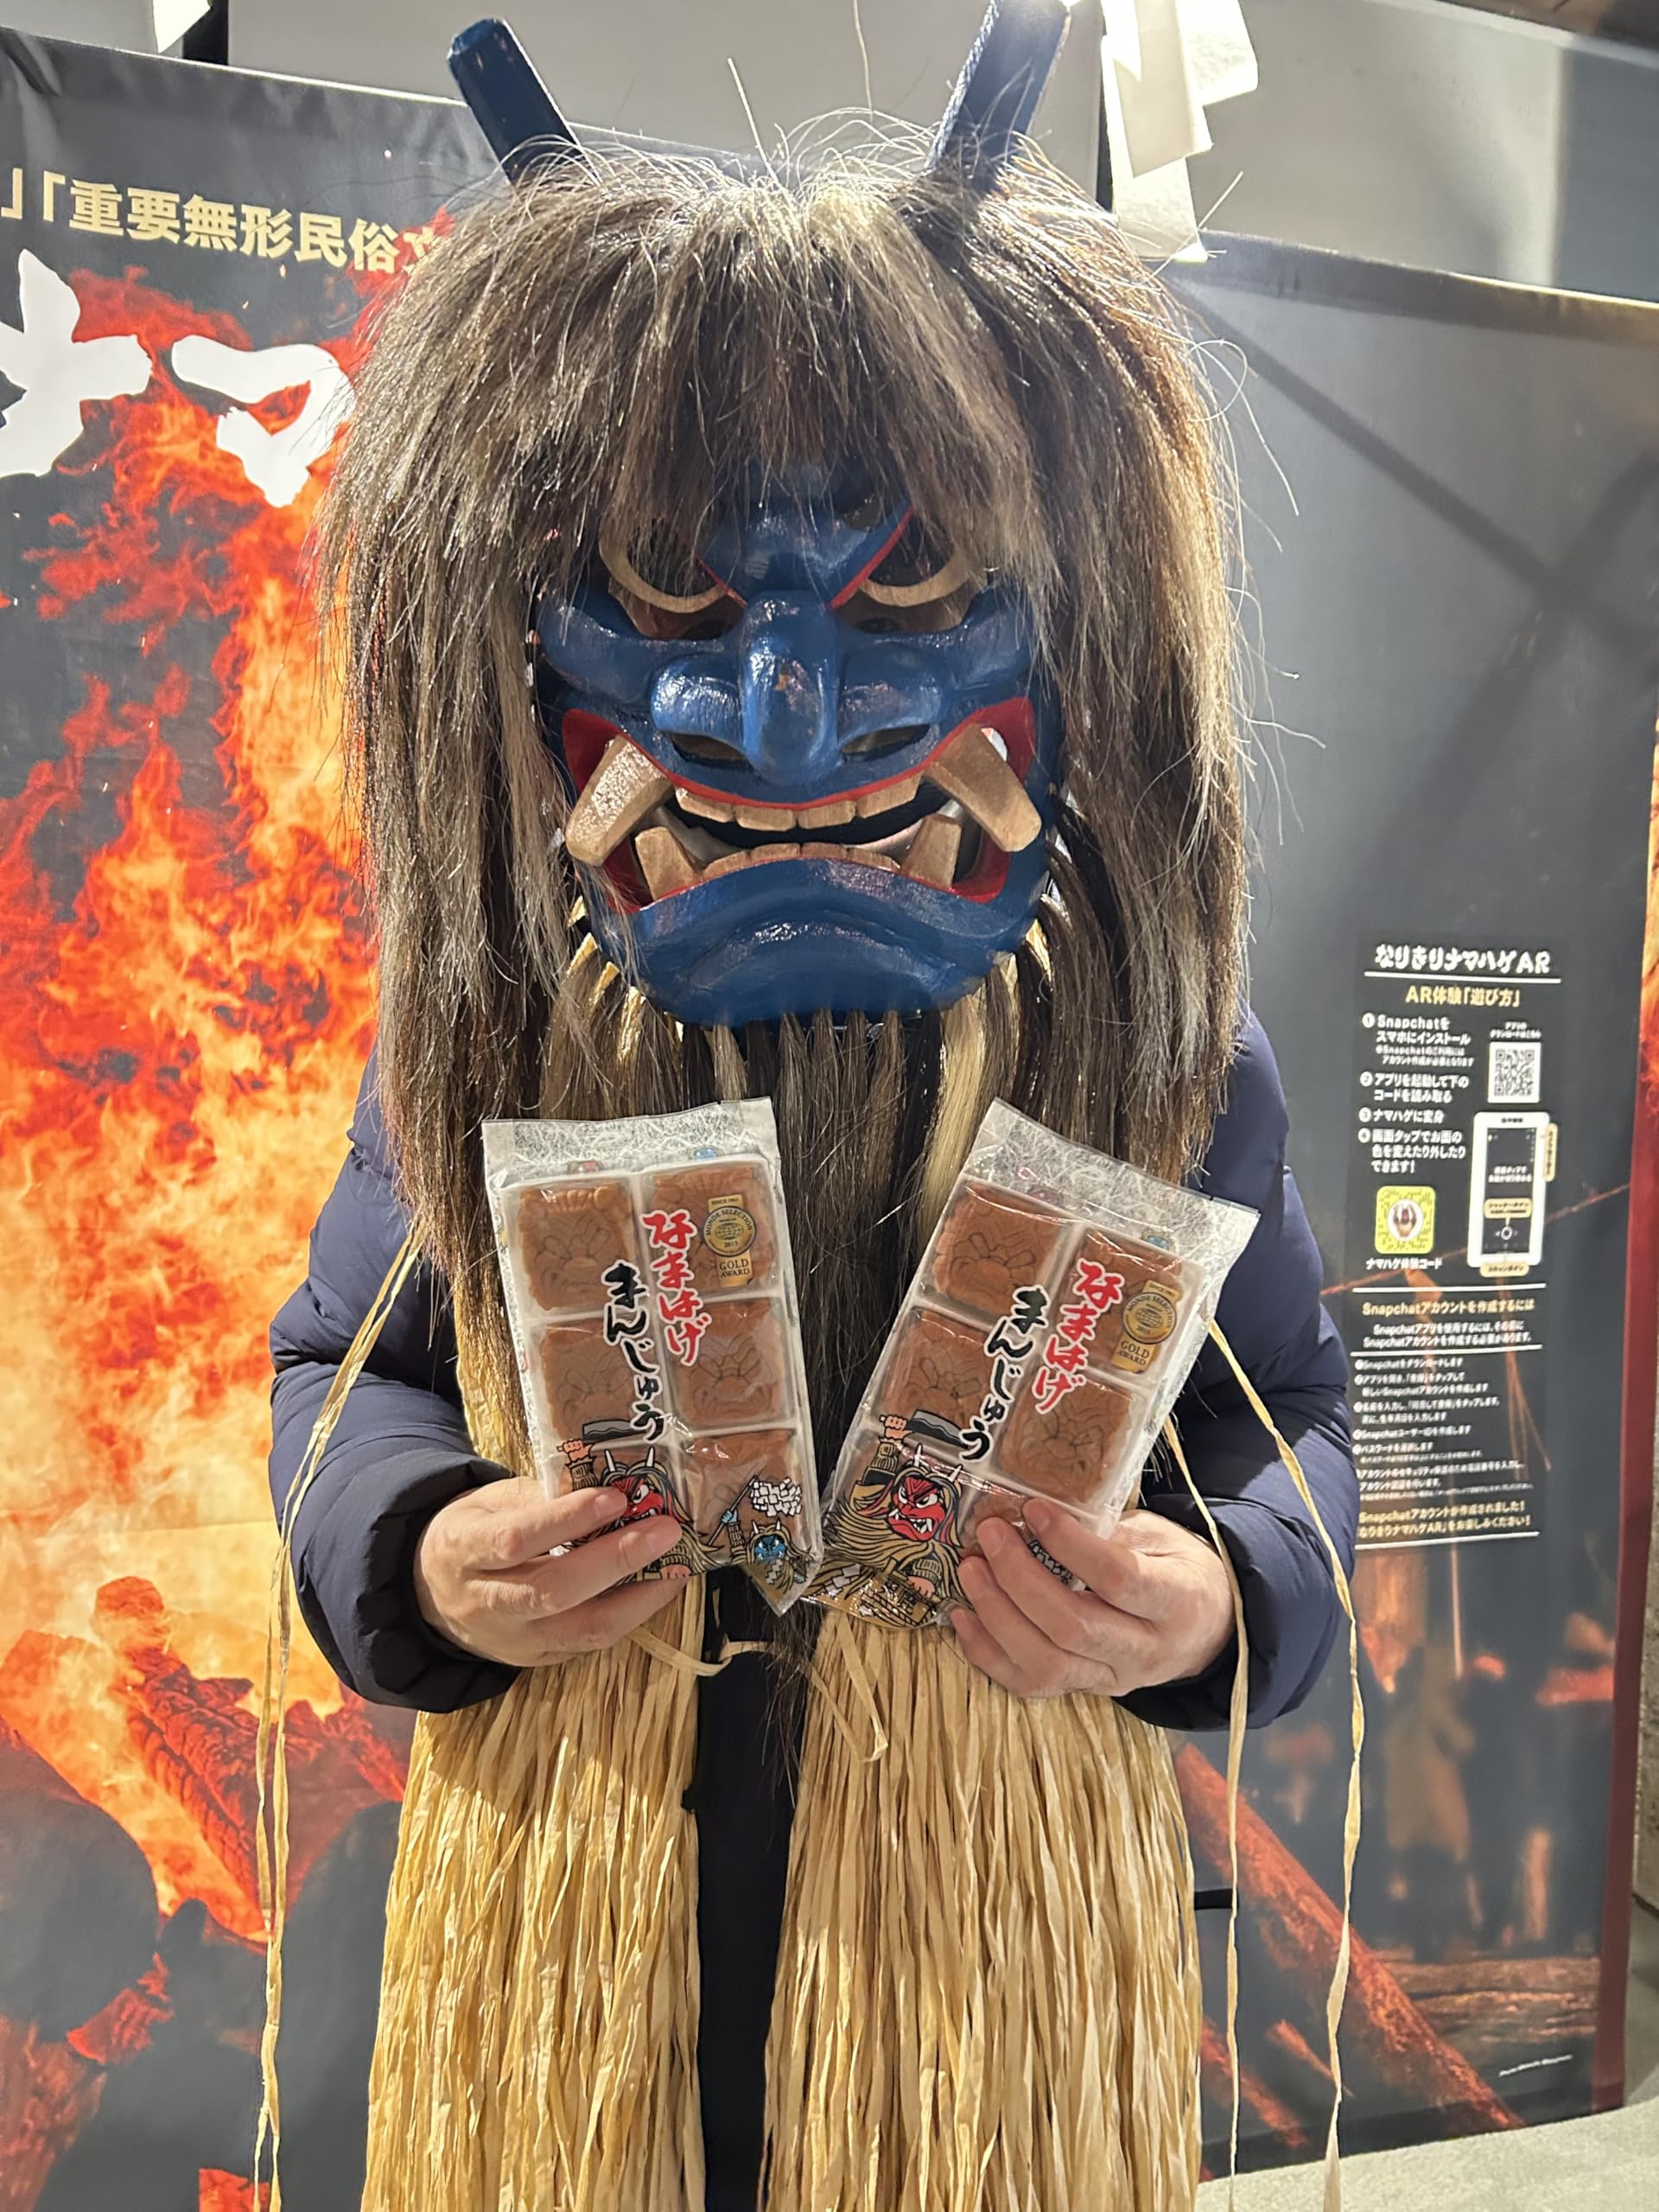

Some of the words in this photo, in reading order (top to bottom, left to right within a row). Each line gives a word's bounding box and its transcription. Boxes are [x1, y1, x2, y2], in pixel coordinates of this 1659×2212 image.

[1405, 985, 1521, 1007] AR体験「遊び方」
[642, 1209, 711, 1365] なまはげ
[719, 1259, 749, 1270] GOLD
[721, 1268, 750, 1277] AWARD
[602, 1259, 668, 1443] まんじゅう
[957, 1285, 1050, 1463] まんじゅう
[1033, 1257, 1124, 1414] なまはげ
[1121, 1341, 1149, 1358] GOLD
